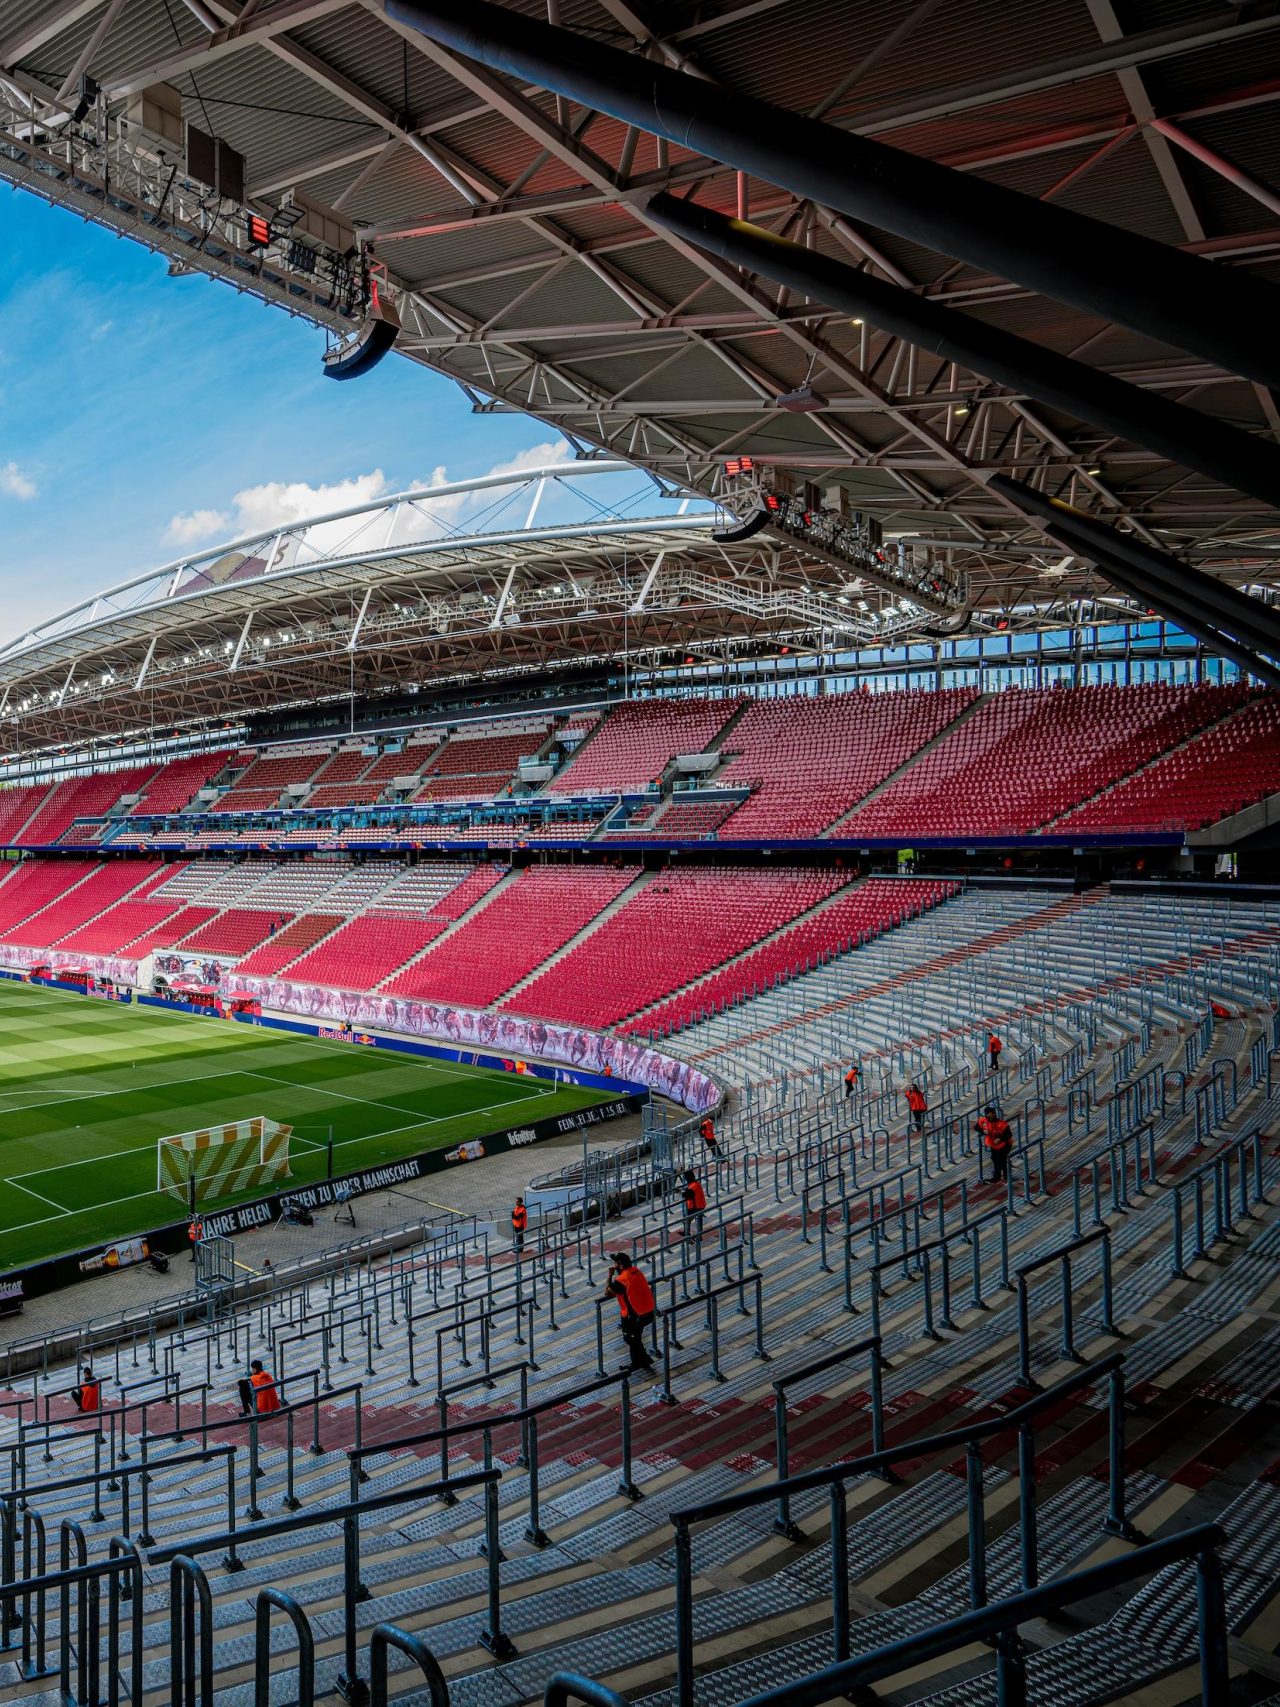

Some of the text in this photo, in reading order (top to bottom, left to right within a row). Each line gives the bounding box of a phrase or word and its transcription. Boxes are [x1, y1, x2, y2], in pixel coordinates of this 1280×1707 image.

[319, 1027, 353, 1042] Red Bull
[317, 1185, 332, 1204] ZU
[362, 1160, 420, 1190] MANNSCHAFT
